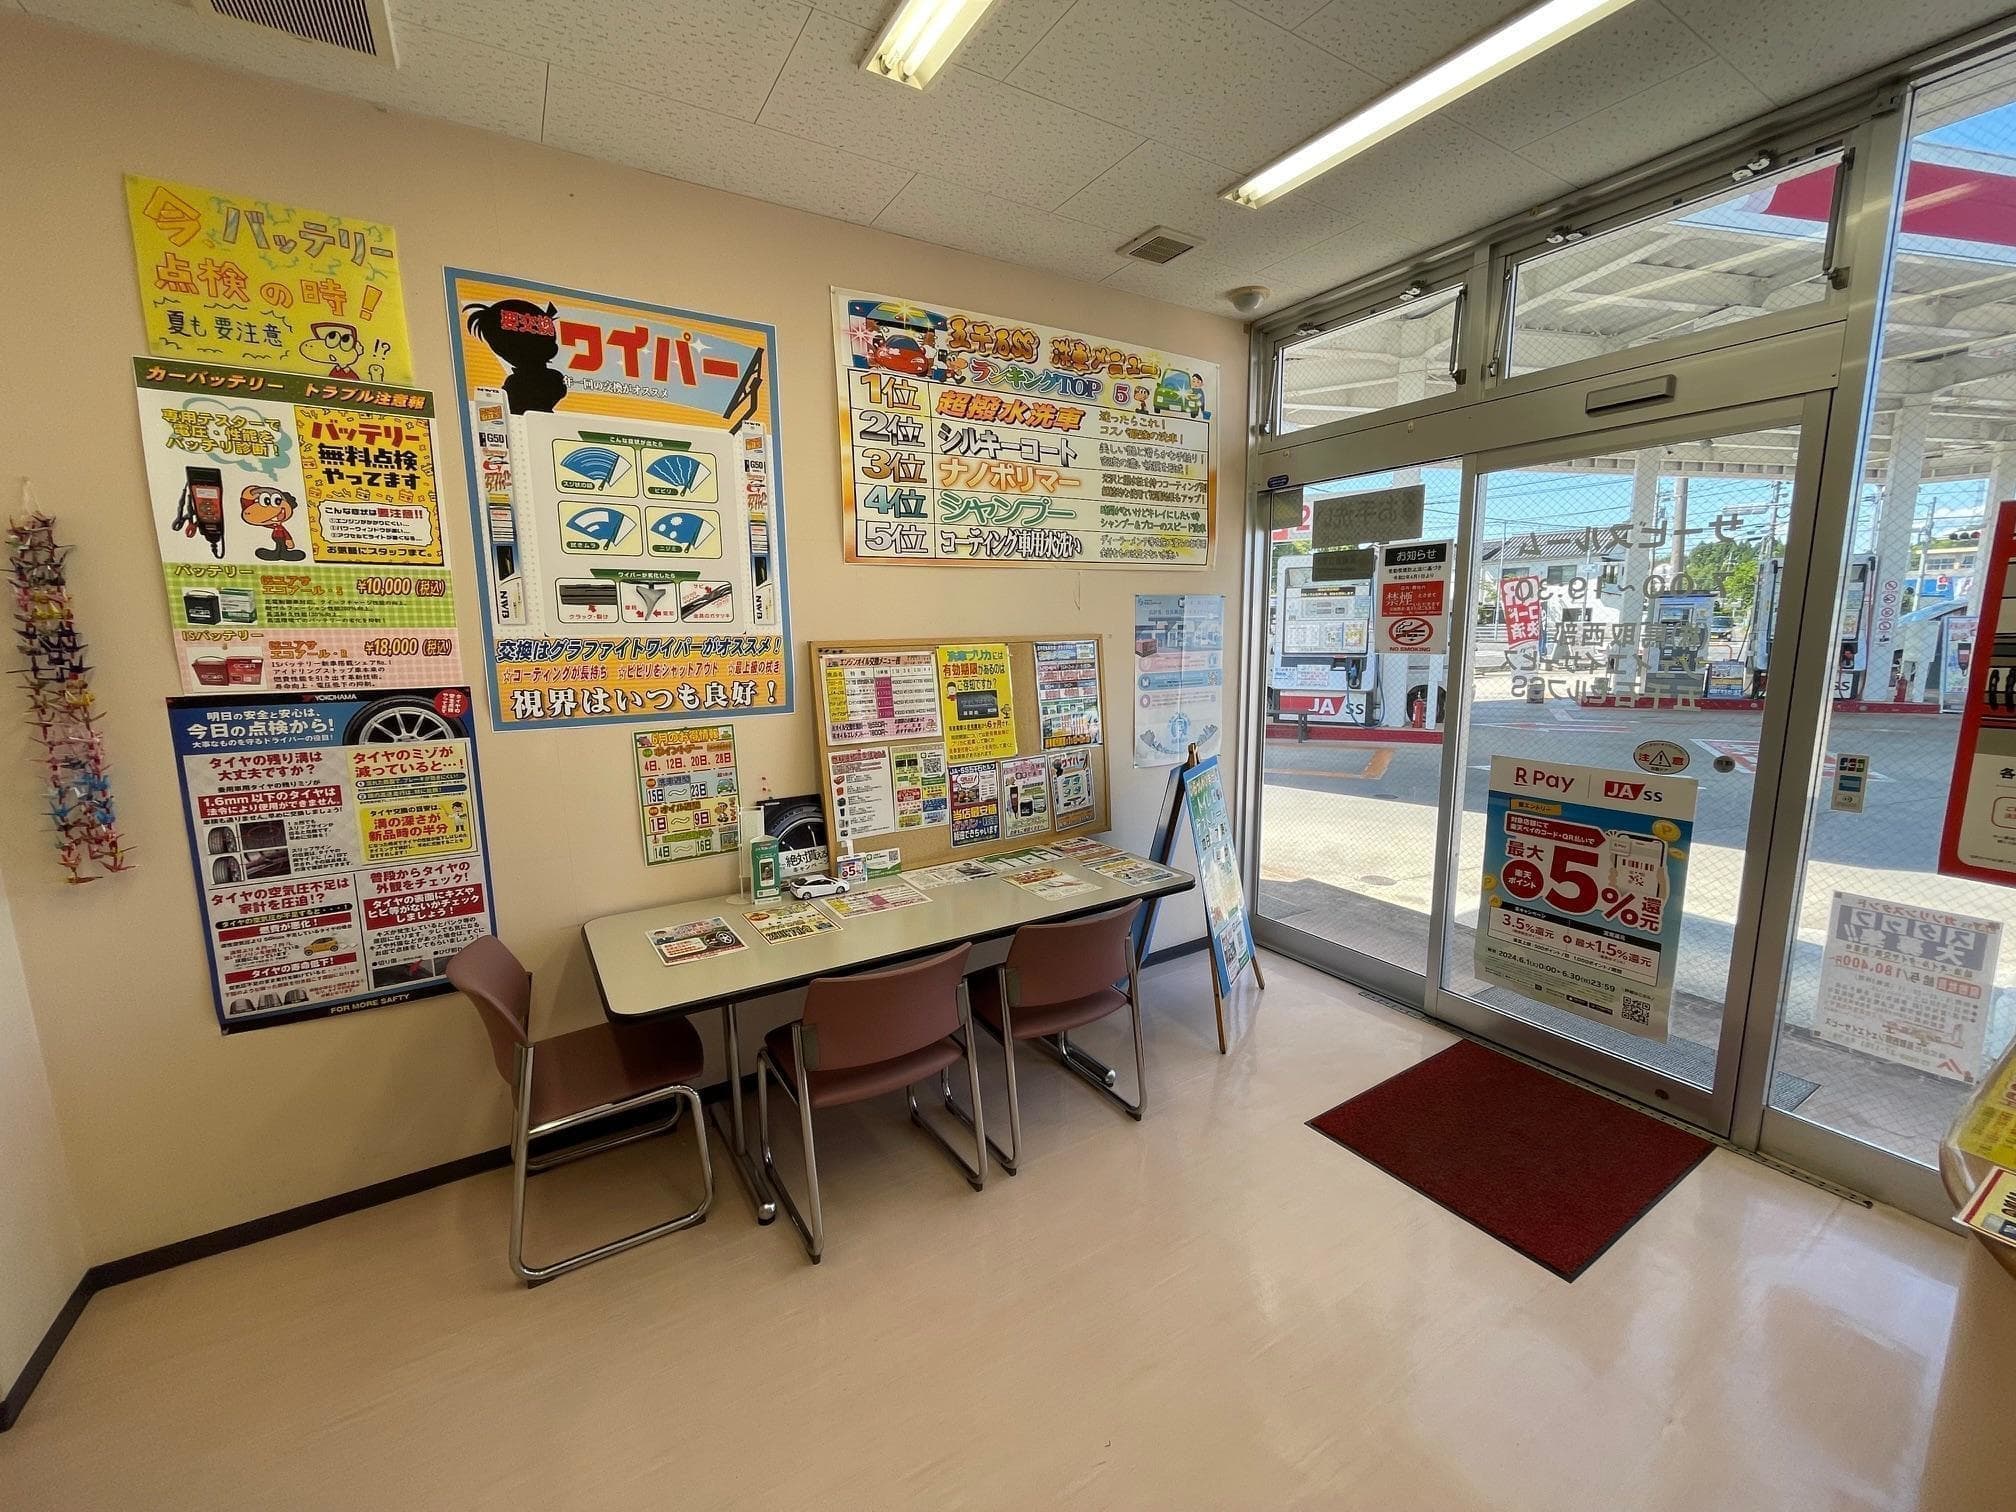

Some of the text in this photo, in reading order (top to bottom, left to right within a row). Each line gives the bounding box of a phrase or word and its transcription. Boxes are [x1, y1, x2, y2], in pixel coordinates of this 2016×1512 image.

[155, 252, 383, 322] 点検の時！
[168, 310, 283, 348] 夏も要注意
[500, 308, 554, 337] 要交換
[559, 320, 740, 386] ワイパー
[146, 365, 426, 412] カーバッテリー トラブル注意報
[1114, 383, 1130, 405] 5
[860, 373, 1086, 431] 1位 超撥水洗車
[161, 408, 280, 432] 専用テスターで
[312, 419, 419, 448] バッテリー
[859, 410, 925, 447] 2位
[939, 423, 1078, 467] シルキーコート
[318, 443, 418, 471] 無料点検
[323, 468, 420, 490] やってます
[861, 447, 928, 484] 3位
[940, 458, 1081, 493] ナノポリマー
[863, 485, 1077, 526] 4位 シャンプー
[864, 521, 928, 554] 5位
[1396, 549, 1437, 562] お知らせ
[175, 564, 254, 578] バッテリー
[357, 577, 445, 597] ¥10,000 (税込)
[499, 590, 509, 619] NWB
[755, 595, 763, 620] NWB
[182, 630, 264, 641] ISバッテリー
[364, 638, 452, 657] ¥18,000 (税込)
[495, 636, 781, 663] 交換はグラファイトワイパーがオススメ！
[315, 693, 357, 701] YOKOHAMA
[511, 681, 776, 719] 視界はいつも良好！
[1307, 697, 1365, 715] JA SS
[206, 708, 321, 722] 明日の安全と安心は、
[186, 718, 335, 740] 今日の点検から！
[209, 751, 323, 769] タイヤの残り溝は
[353, 746, 454, 765] タイヤのミゾが
[217, 763, 316, 781] 大丈夫ですか？
[1513, 766, 1529, 787] R
[1532, 770, 1576, 793] Pay
[1606, 782, 1635, 799] JA
[206, 799, 341, 816] 法令により使用ができません。
[368, 823, 449, 842] 新品時の半分
[1507, 840, 1545, 862] 最大
[369, 861, 471, 884] 普段からタイヤの
[376, 873, 469, 894] 外観をチェック！
[1507, 876, 1537, 890] ポイント
[211, 877, 350, 906] タイヤの空気圧不足は
[372, 887, 475, 908] タイヤの表面にキズや
[238, 893, 325, 915] 家計を圧迫!?
[368, 895, 480, 919] ヒビ等がないかチェック
[396, 907, 455, 924] しましょう！
[1502, 913, 1653, 968] 3.5%還元 最大1.5%還元
[251, 958, 335, 978] タイヤの寿命低下！
[330, 993, 410, 1014] FOR MORE SAFTY
